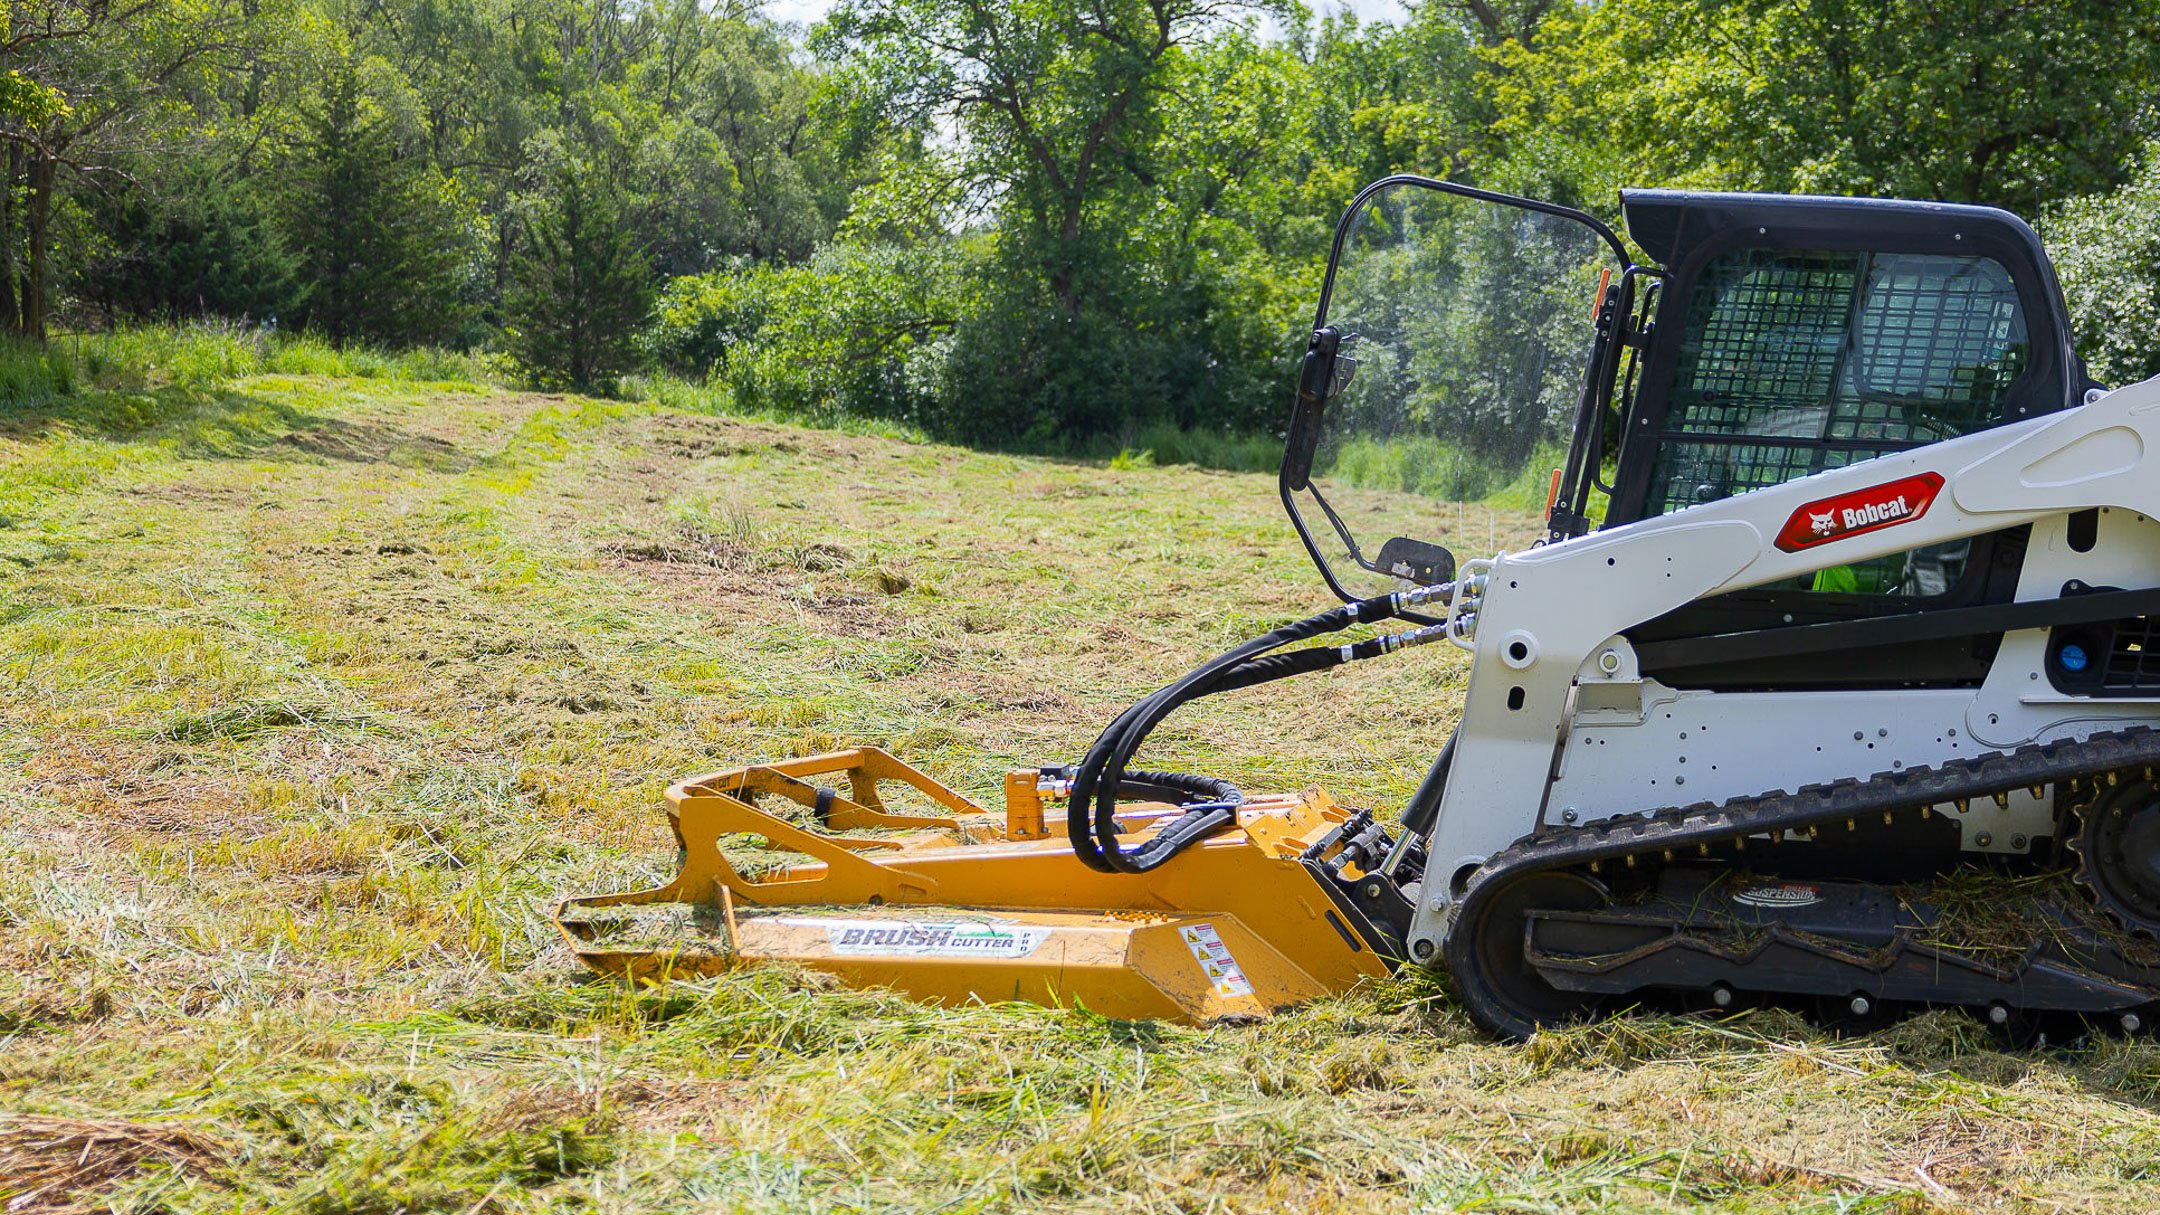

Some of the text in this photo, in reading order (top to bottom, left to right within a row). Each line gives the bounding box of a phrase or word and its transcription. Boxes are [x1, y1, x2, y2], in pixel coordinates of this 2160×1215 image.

[1841, 495, 1908, 530] Bobcat
[839, 929, 1031, 952] BRUSH CUTTER PRO
